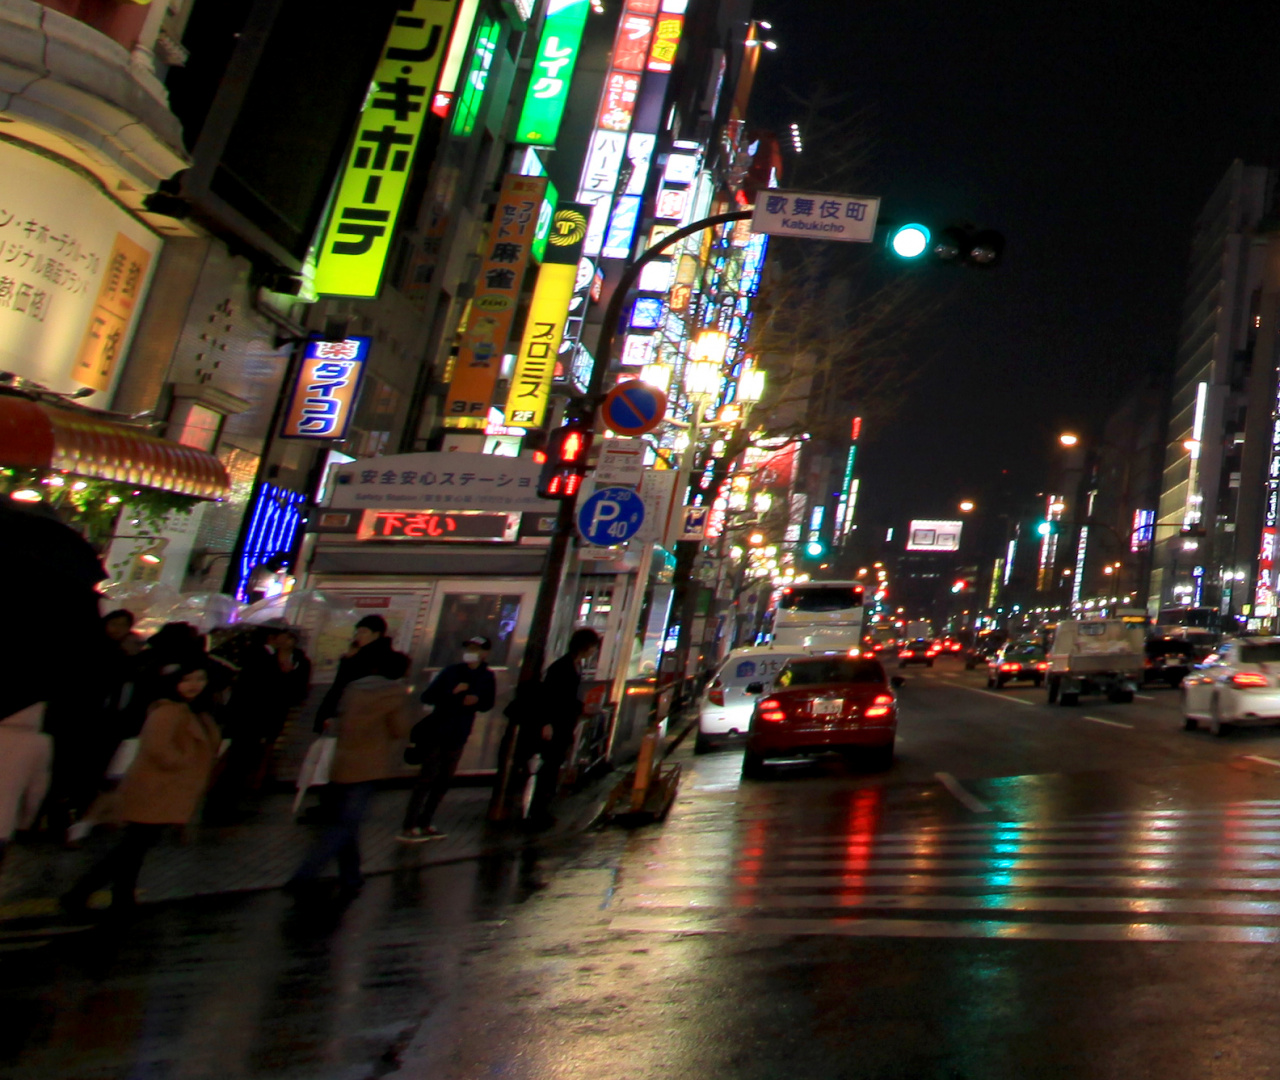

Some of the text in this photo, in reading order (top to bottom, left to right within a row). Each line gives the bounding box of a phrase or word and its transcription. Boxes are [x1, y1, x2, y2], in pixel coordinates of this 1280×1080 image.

[532, 35, 572, 99] レイク
[497, 204, 518, 238] セット
[518, 201, 535, 236] フリー
[765, 195, 869, 222] 歌舞伎町
[780, 217, 846, 234] Kabukicho
[485, 242, 523, 290] 麻雀
[517, 321, 557, 399] プロミス
[297, 360, 353, 436] ダイコク
[450, 400, 484, 412] 3F
[513, 410, 534, 421] 2F
[360, 469, 541, 489] 安全安心ステーショ
[603, 490, 631, 501] 7-20
[376, 512, 457, 536] 下さい
[589, 500, 621, 537] P
[607, 521, 628, 538] 40
